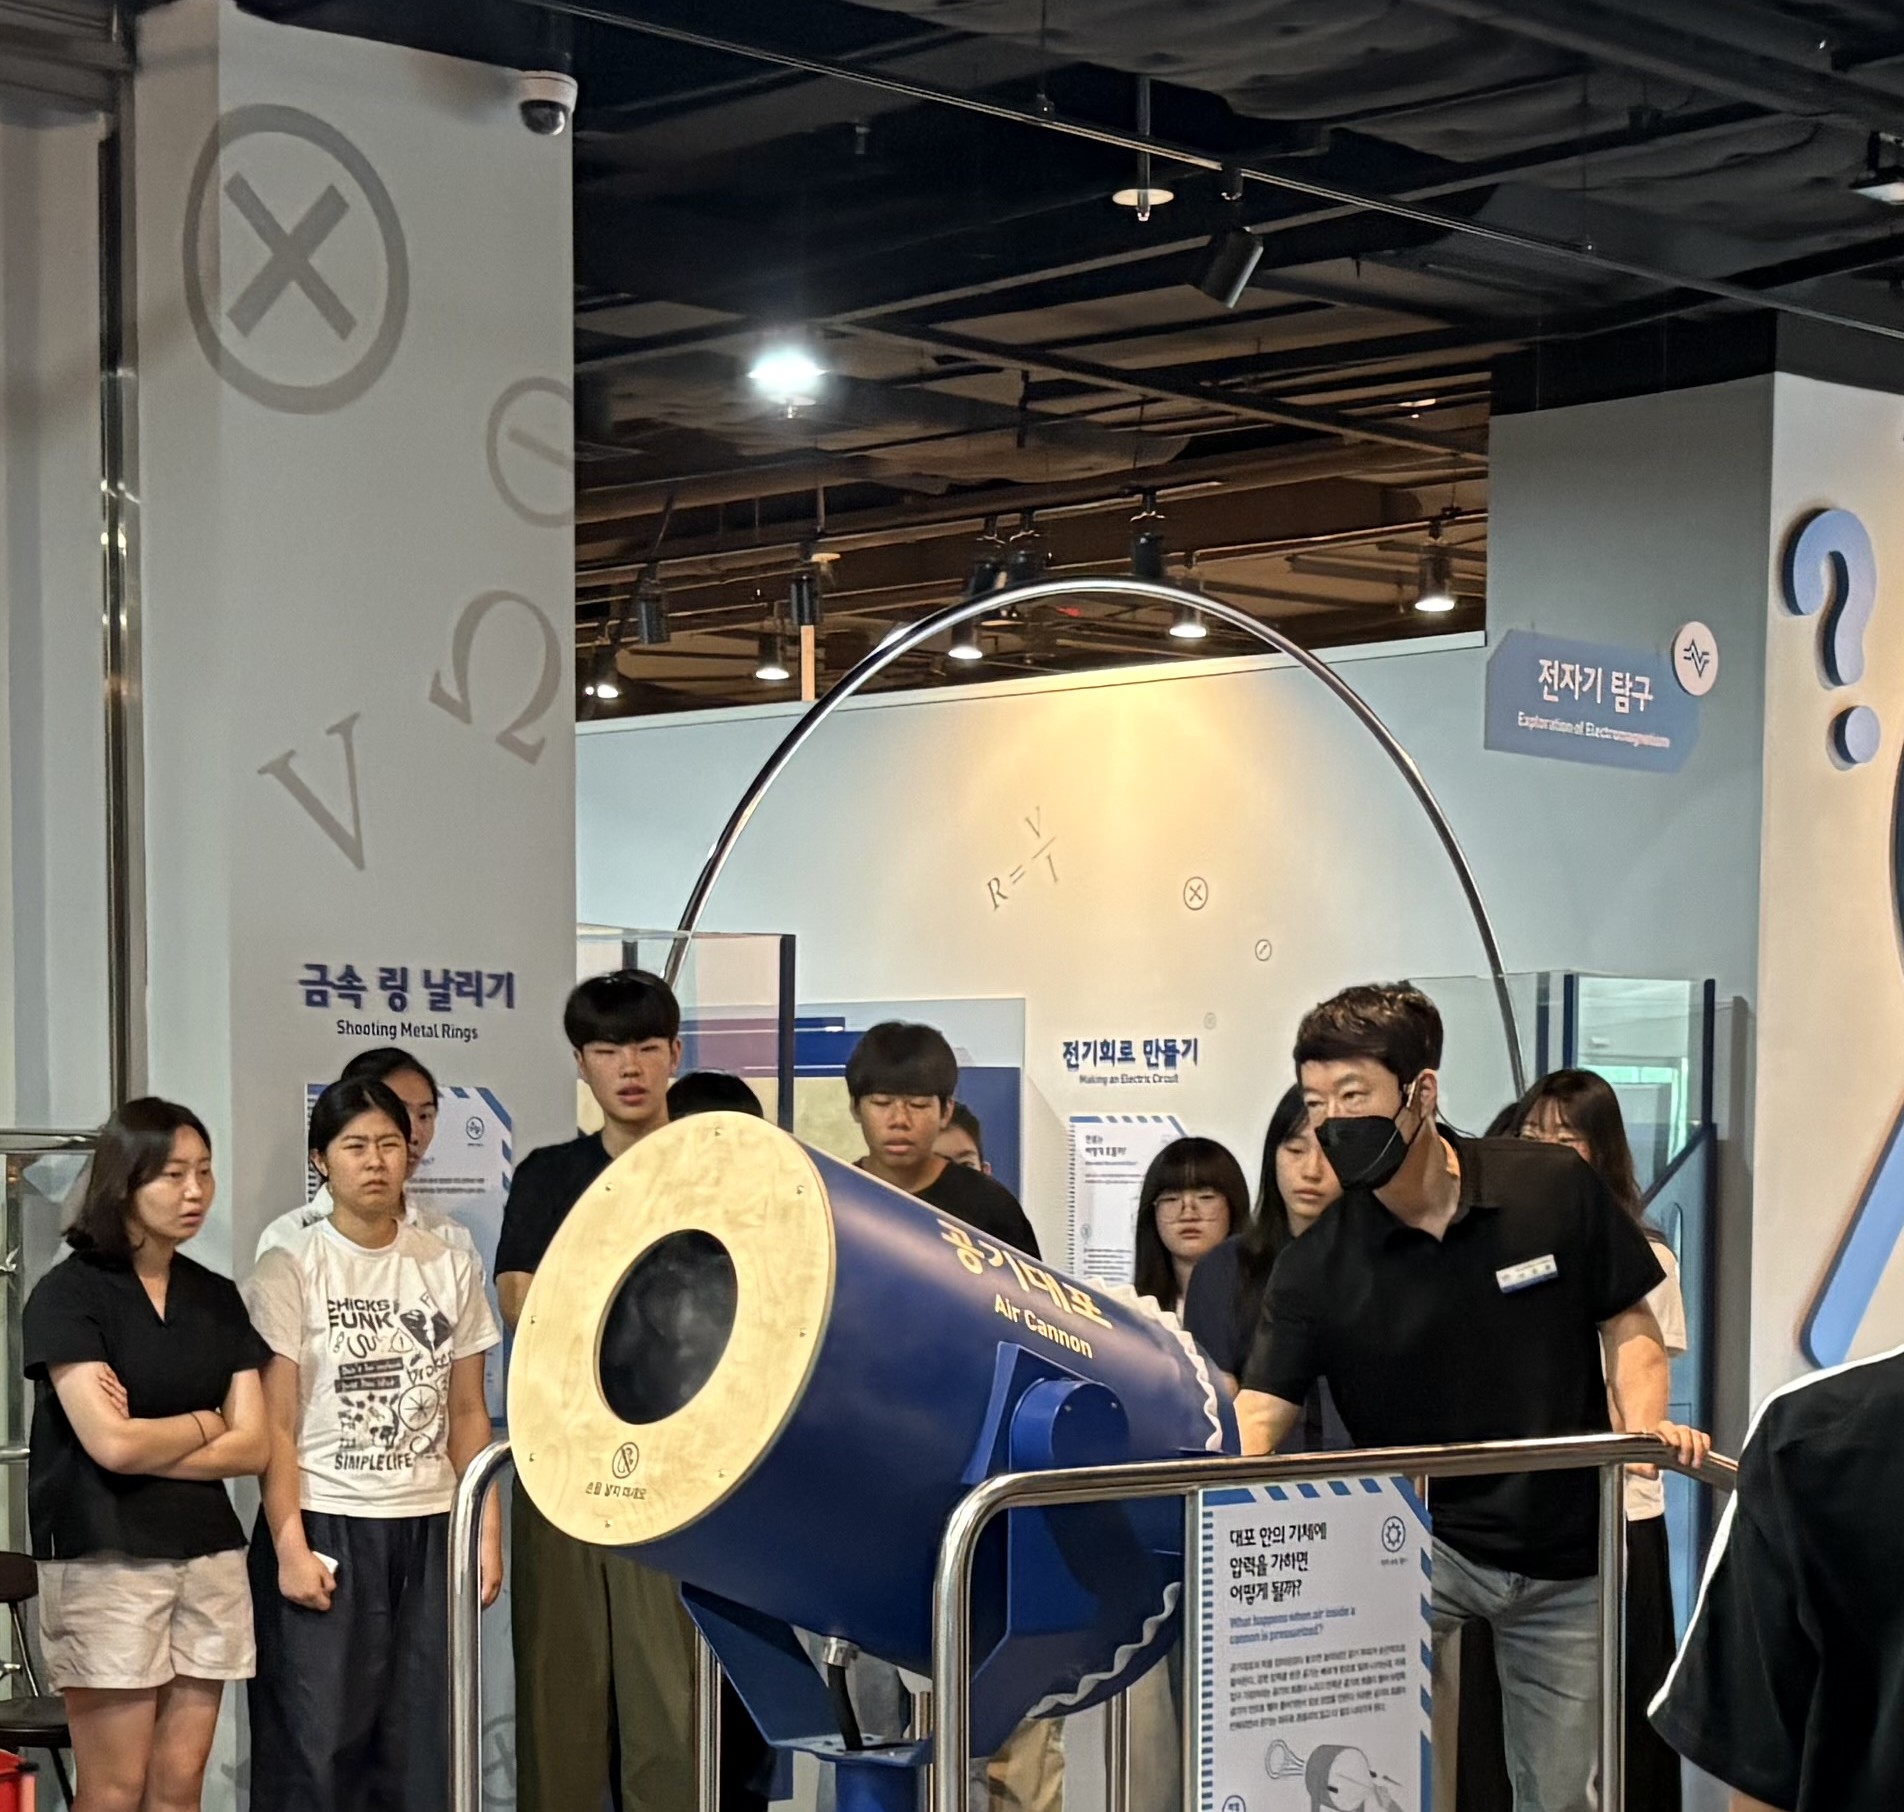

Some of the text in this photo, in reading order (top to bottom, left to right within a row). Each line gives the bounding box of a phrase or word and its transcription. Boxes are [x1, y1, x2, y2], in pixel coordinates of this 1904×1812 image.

[1538, 658, 1654, 714] 전자기 탐구
[298, 963, 515, 1012] 금속 링 날리기
[336, 1019, 479, 1043] Shooting Metal Rings
[1062, 1038, 1198, 1071] 전기회로 만들기
[936, 1218, 1113, 1329] 공기대포
[328, 1311, 395, 1334] FUNK
[994, 1293, 1094, 1359] Air Cannon
[334, 1452, 414, 1471] SIMPLE LIFE
[1229, 1522, 1327, 1548] 대포 안의 기체에
[1230, 1551, 1309, 1579] 압력을 가하면
[1230, 1579, 1302, 1606] 어떻게 될까?
